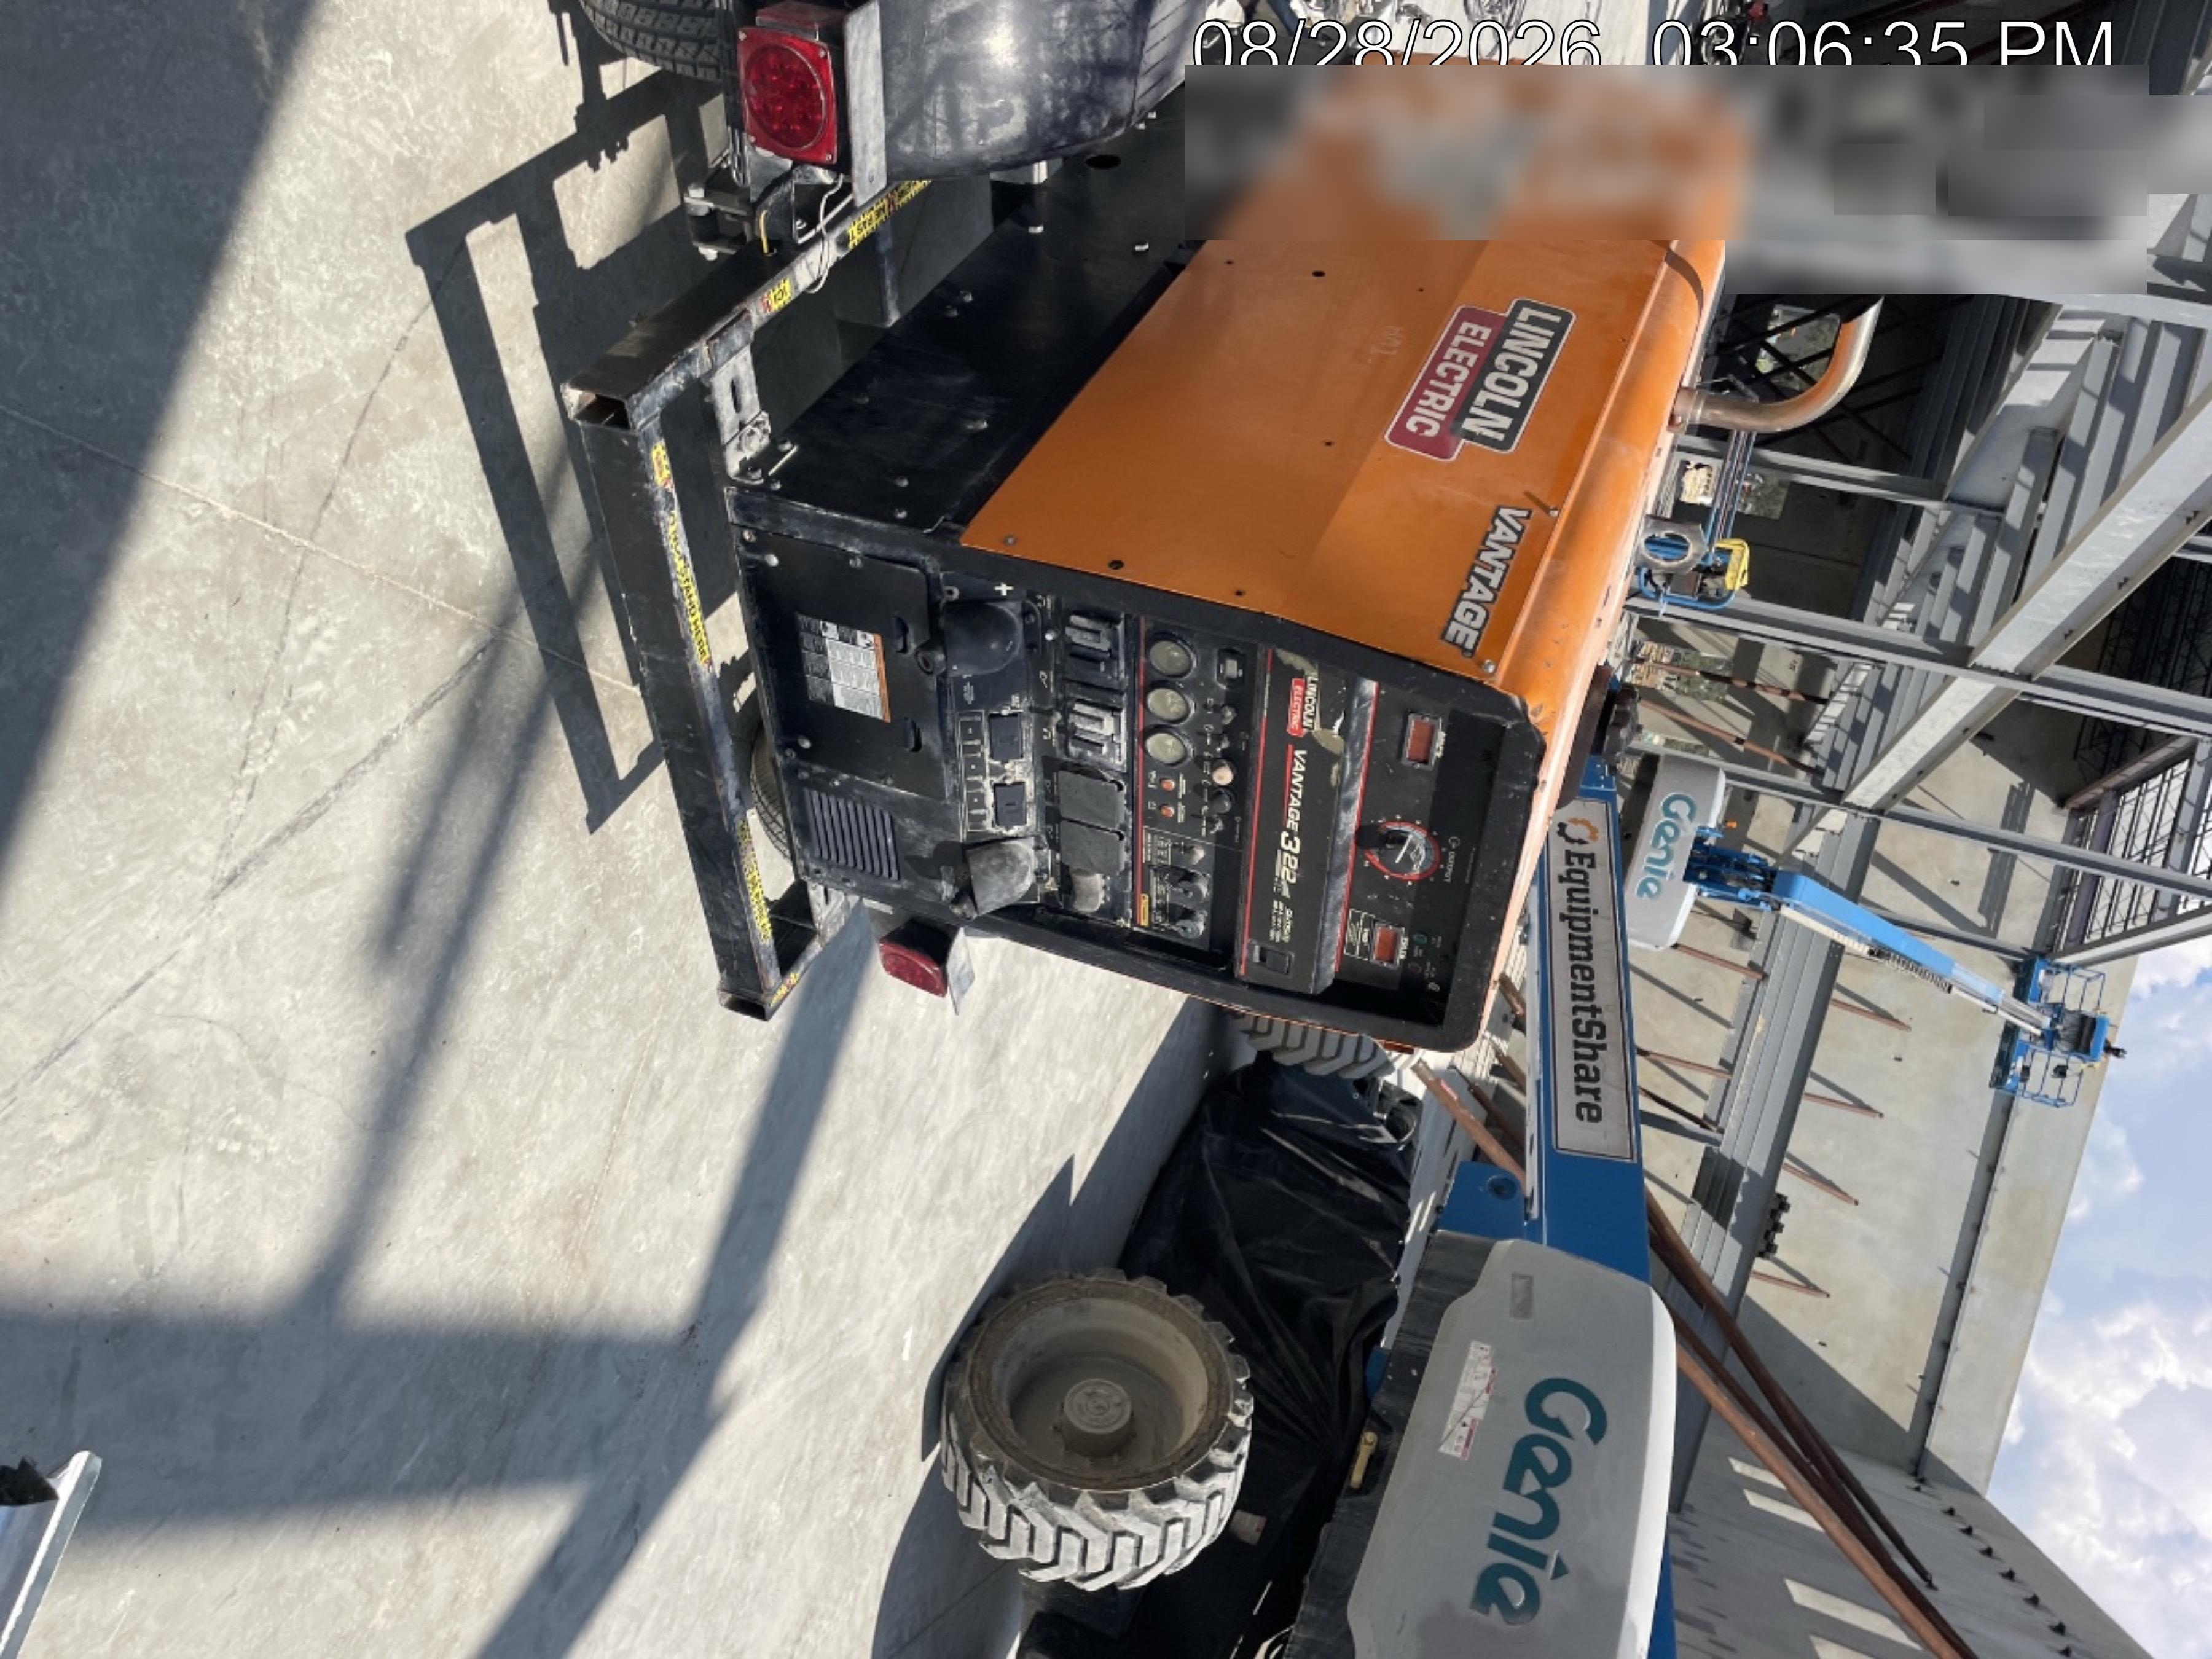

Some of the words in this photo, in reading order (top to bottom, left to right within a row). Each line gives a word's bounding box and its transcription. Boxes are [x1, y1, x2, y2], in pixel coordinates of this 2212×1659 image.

[1406, 322, 1492, 437] ELECTRIC
[1462, 307, 1562, 441] LINCOLN
[1445, 508, 1529, 653] VANTAGE
[1290, 684, 1303, 731] ELECTRIC
[1302, 677, 1319, 728] LINCOLN
[1286, 749, 1308, 831] VANTAGE
[1281, 831, 1300, 883] 322
[1635, 793, 1697, 900] Genie
[1559, 850, 1607, 1123] EquipmentShare
[1470, 1378, 1608, 1626] Genie
